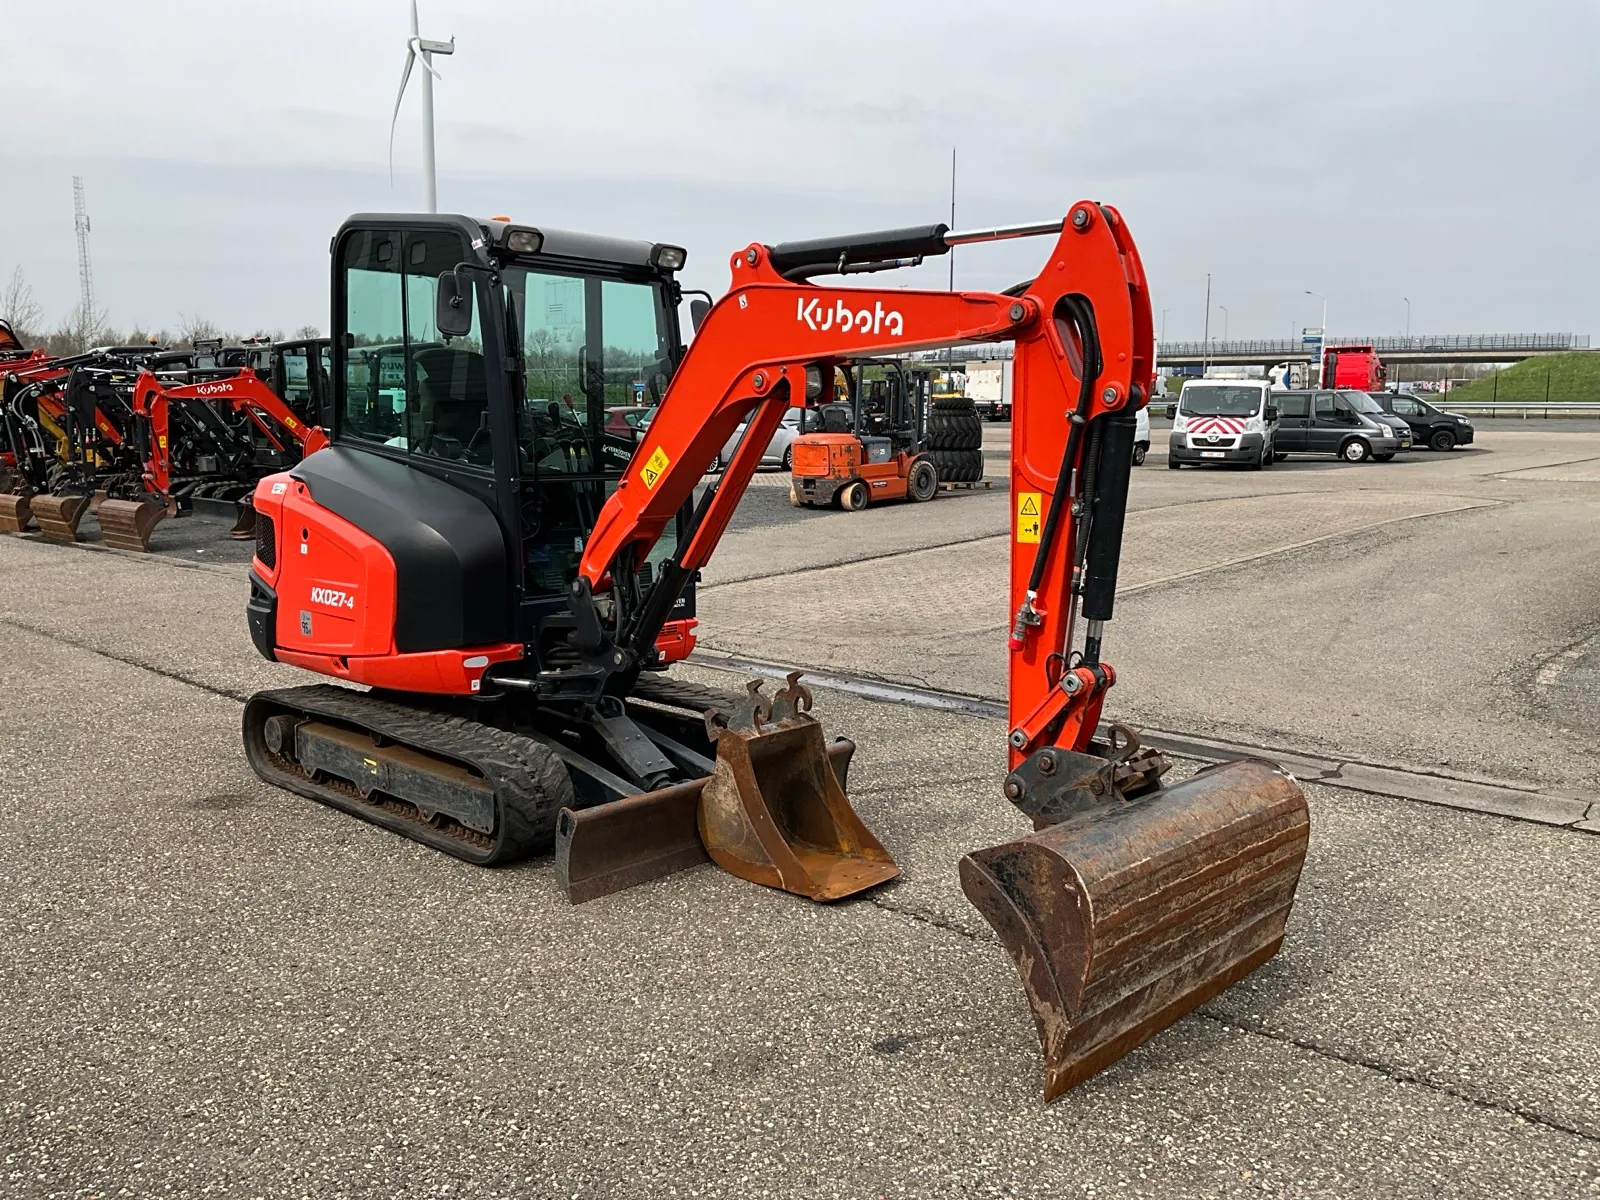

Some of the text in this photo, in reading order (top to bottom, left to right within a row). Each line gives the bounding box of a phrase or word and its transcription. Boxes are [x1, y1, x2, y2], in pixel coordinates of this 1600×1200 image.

[797, 297, 903, 336] Kubota
[196, 383, 233, 395] Kubota
[311, 586, 354, 610] KX027-4
